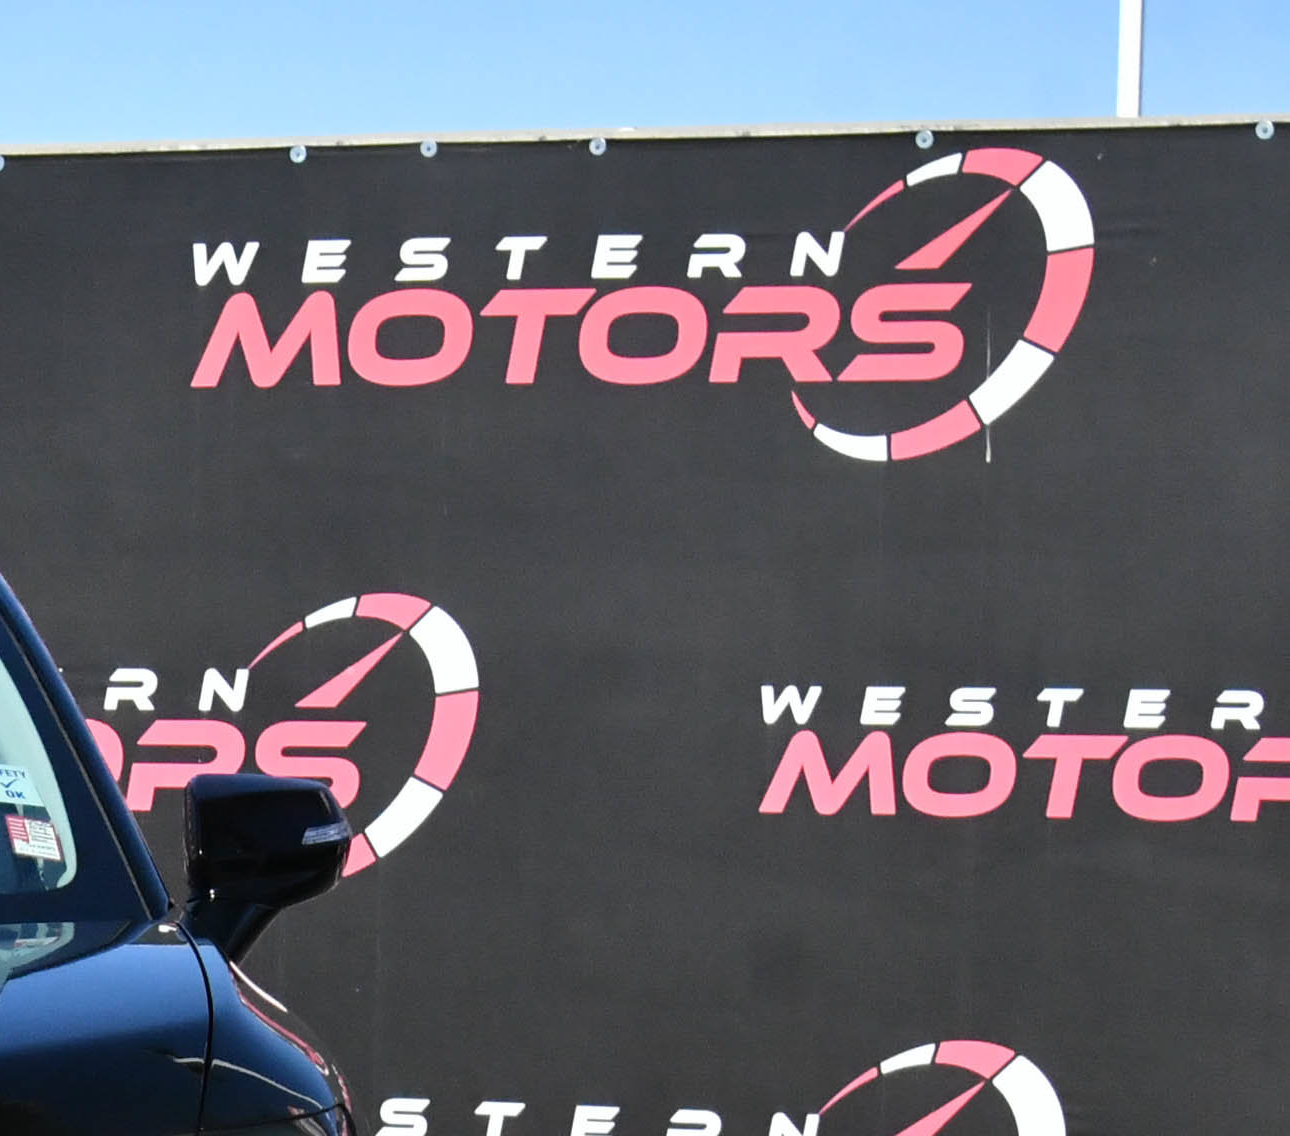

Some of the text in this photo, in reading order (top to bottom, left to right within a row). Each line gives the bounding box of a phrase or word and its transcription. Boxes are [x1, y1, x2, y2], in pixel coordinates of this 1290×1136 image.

[192, 231, 846, 287] WESTERN
[191, 282, 972, 389] MOTORS
[760, 684, 1266, 731] WESTER
[5, 789, 26, 800] OK
